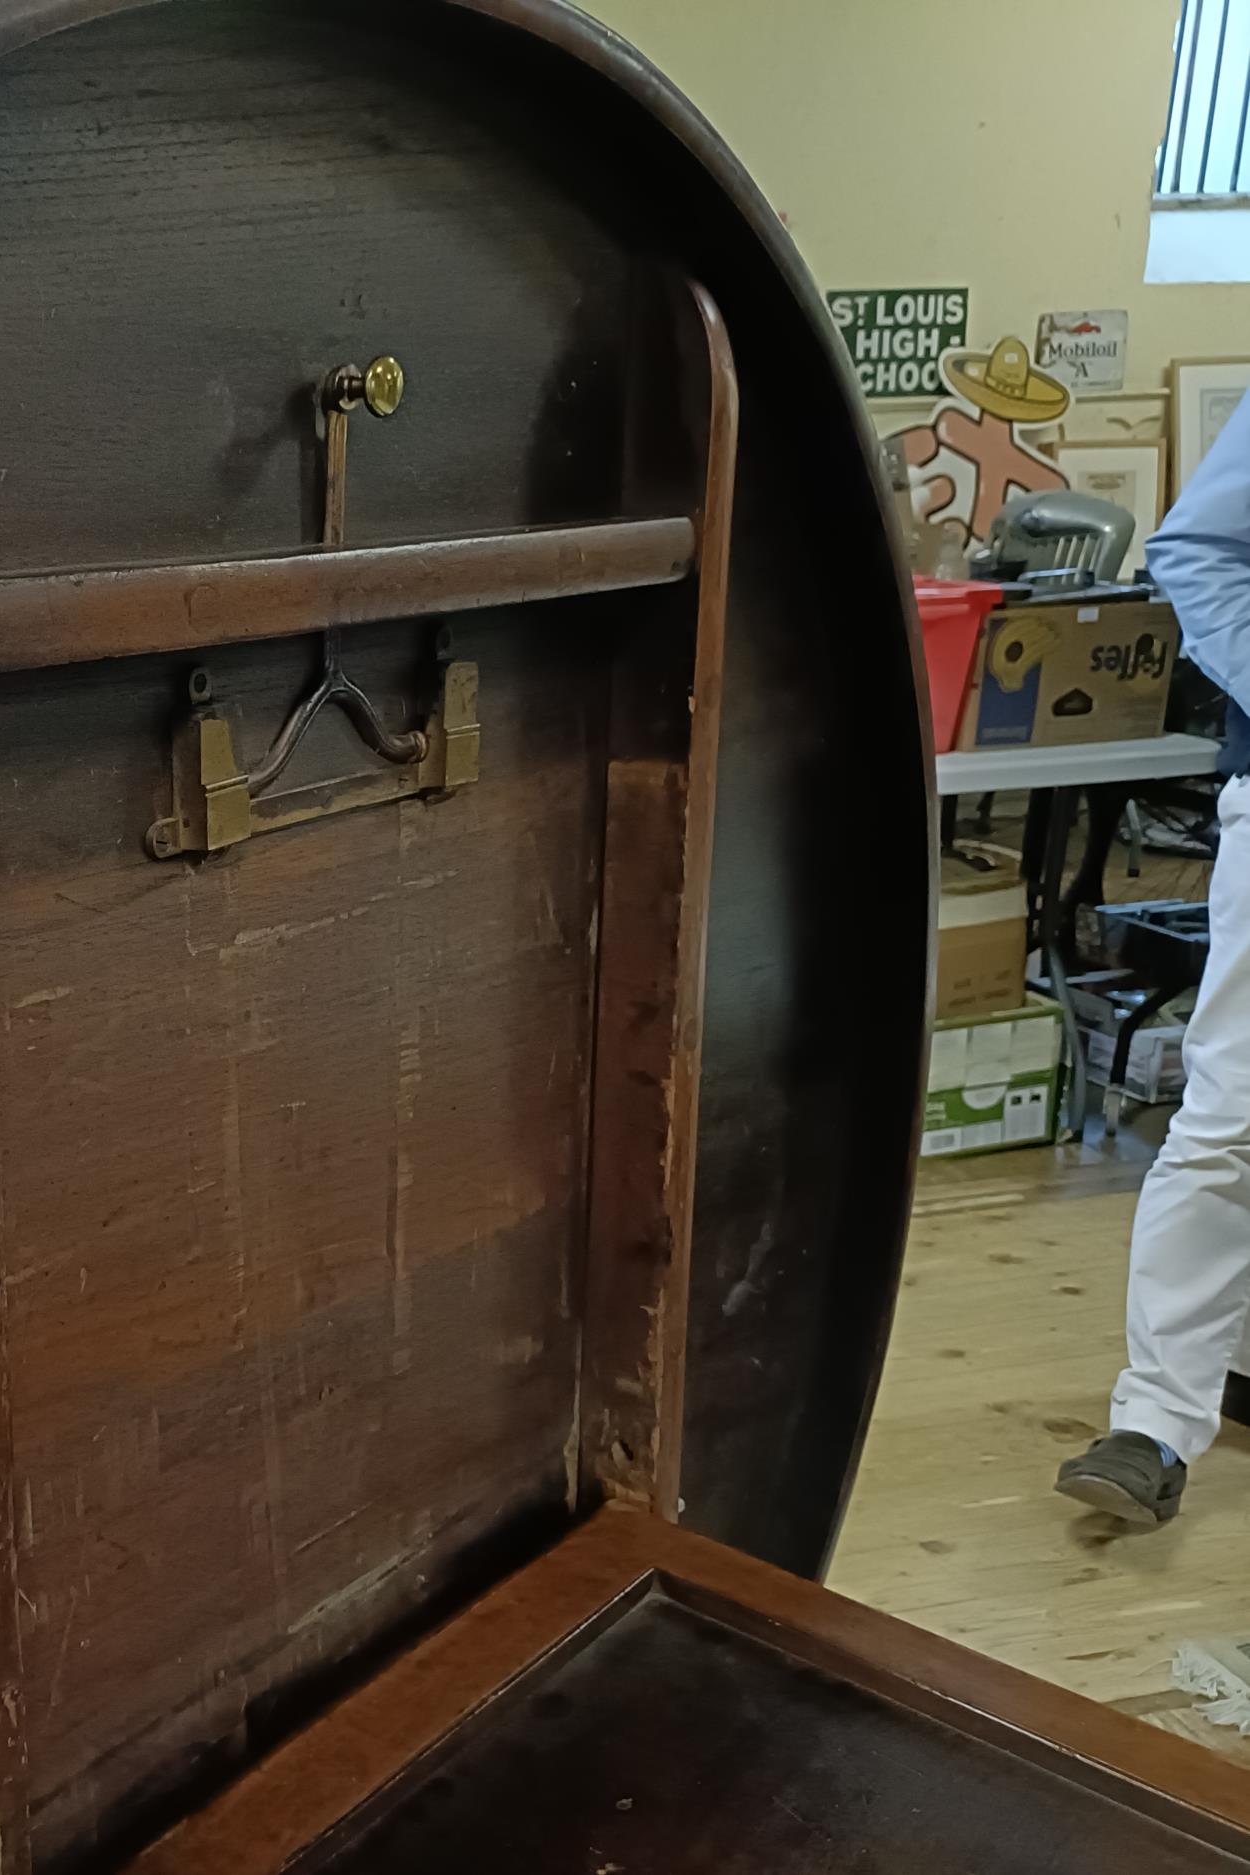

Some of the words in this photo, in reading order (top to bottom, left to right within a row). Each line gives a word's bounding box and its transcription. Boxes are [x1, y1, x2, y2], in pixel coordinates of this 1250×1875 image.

[876, 294, 964, 325] LOUIS
[1049, 341, 1117, 359] Mobiloil
[855, 361, 940, 391] CHOO
